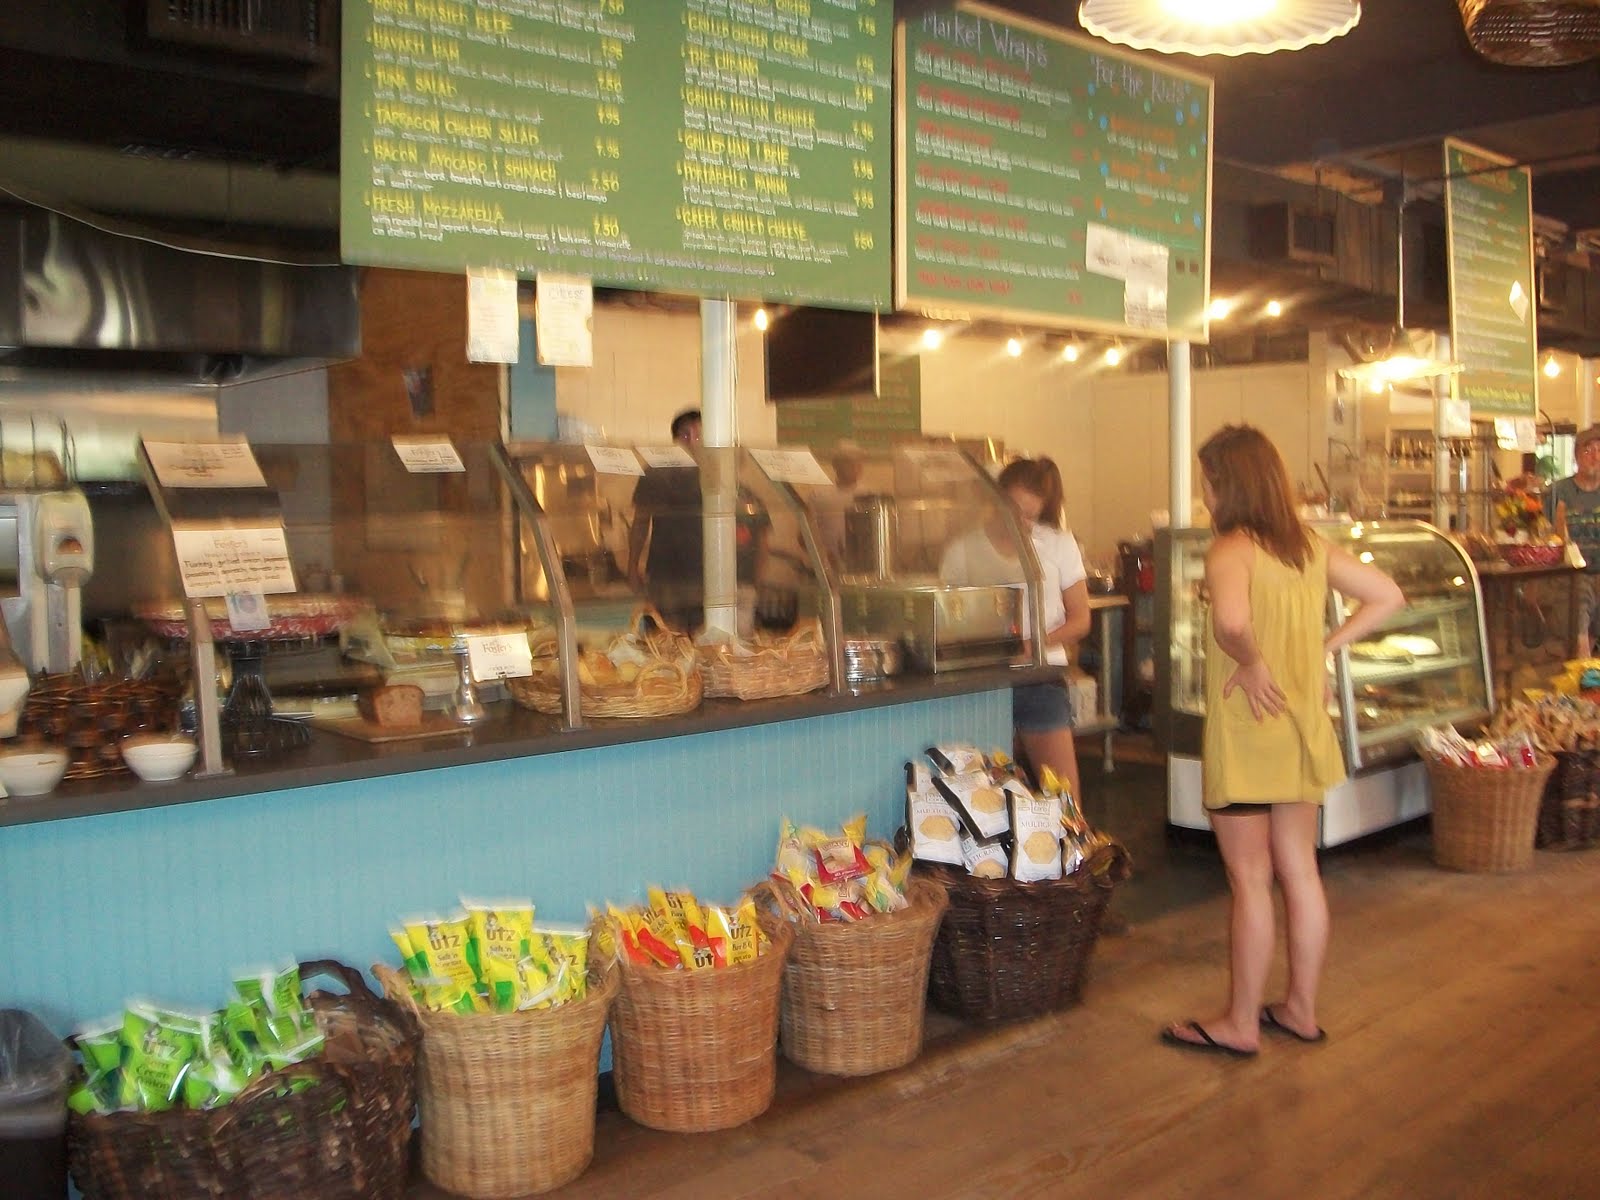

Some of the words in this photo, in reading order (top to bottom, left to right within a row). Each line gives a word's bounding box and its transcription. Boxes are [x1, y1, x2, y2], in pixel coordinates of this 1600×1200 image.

[923, 9, 983, 53] Market
[989, 21, 1048, 72] Wraps
[1091, 57, 1115, 88] For
[1121, 64, 1145, 98] the
[375, 108, 440, 134] TARRAGON
[499, 126, 541, 146] SALAD
[373, 144, 418, 165] BACON
[429, 152, 489, 175] AVOCADO
[504, 162, 557, 183] SPINACH
[591, 177, 620, 192] 7.50
[372, 196, 415, 215] FRESH
[422, 200, 505, 225] MOZZARELLA
[593, 222, 620, 238] 7.50
[682, 211, 720, 231] GREEK
[722, 217, 766, 237] GRILLED
[766, 224, 807, 242] CHEESE
[430, 933, 461, 952] utz
[486, 926, 516, 942] utz
[730, 923, 753, 940] utz
[136, 1065, 167, 1079] Cream
